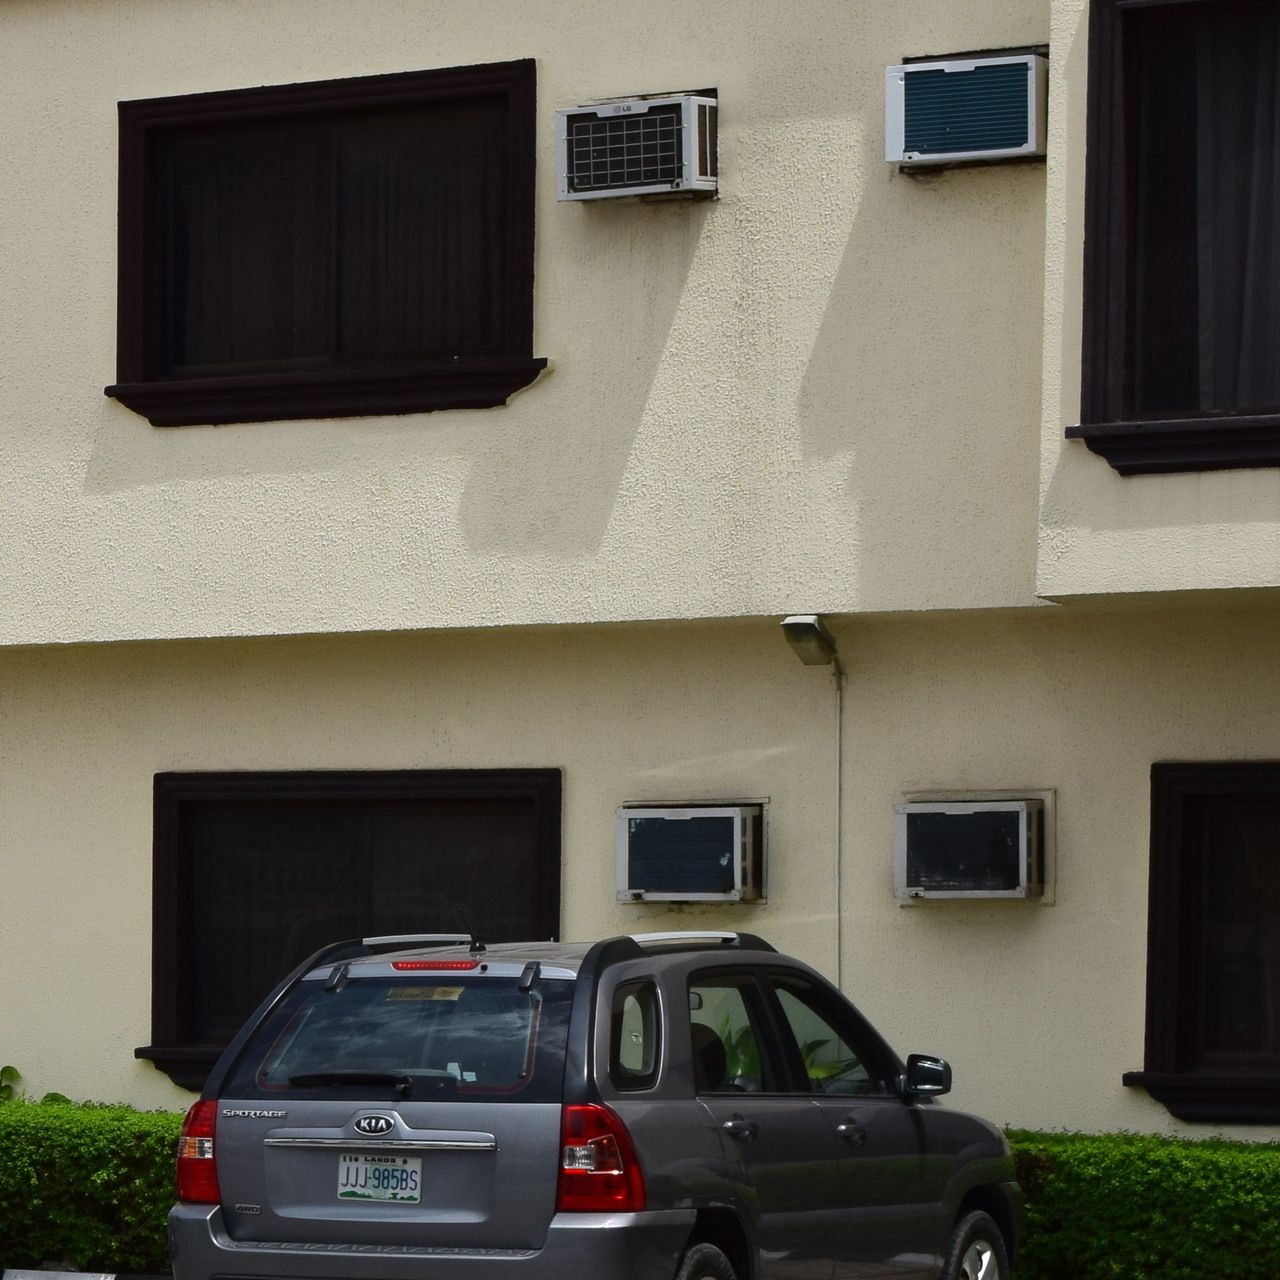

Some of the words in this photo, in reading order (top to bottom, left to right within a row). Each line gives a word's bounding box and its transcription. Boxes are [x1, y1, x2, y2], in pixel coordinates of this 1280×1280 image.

[222, 1109, 287, 1119] SPORTAGE
[360, 1118, 387, 1131] KIA
[340, 1166, 418, 1191] JJJ-985BS
